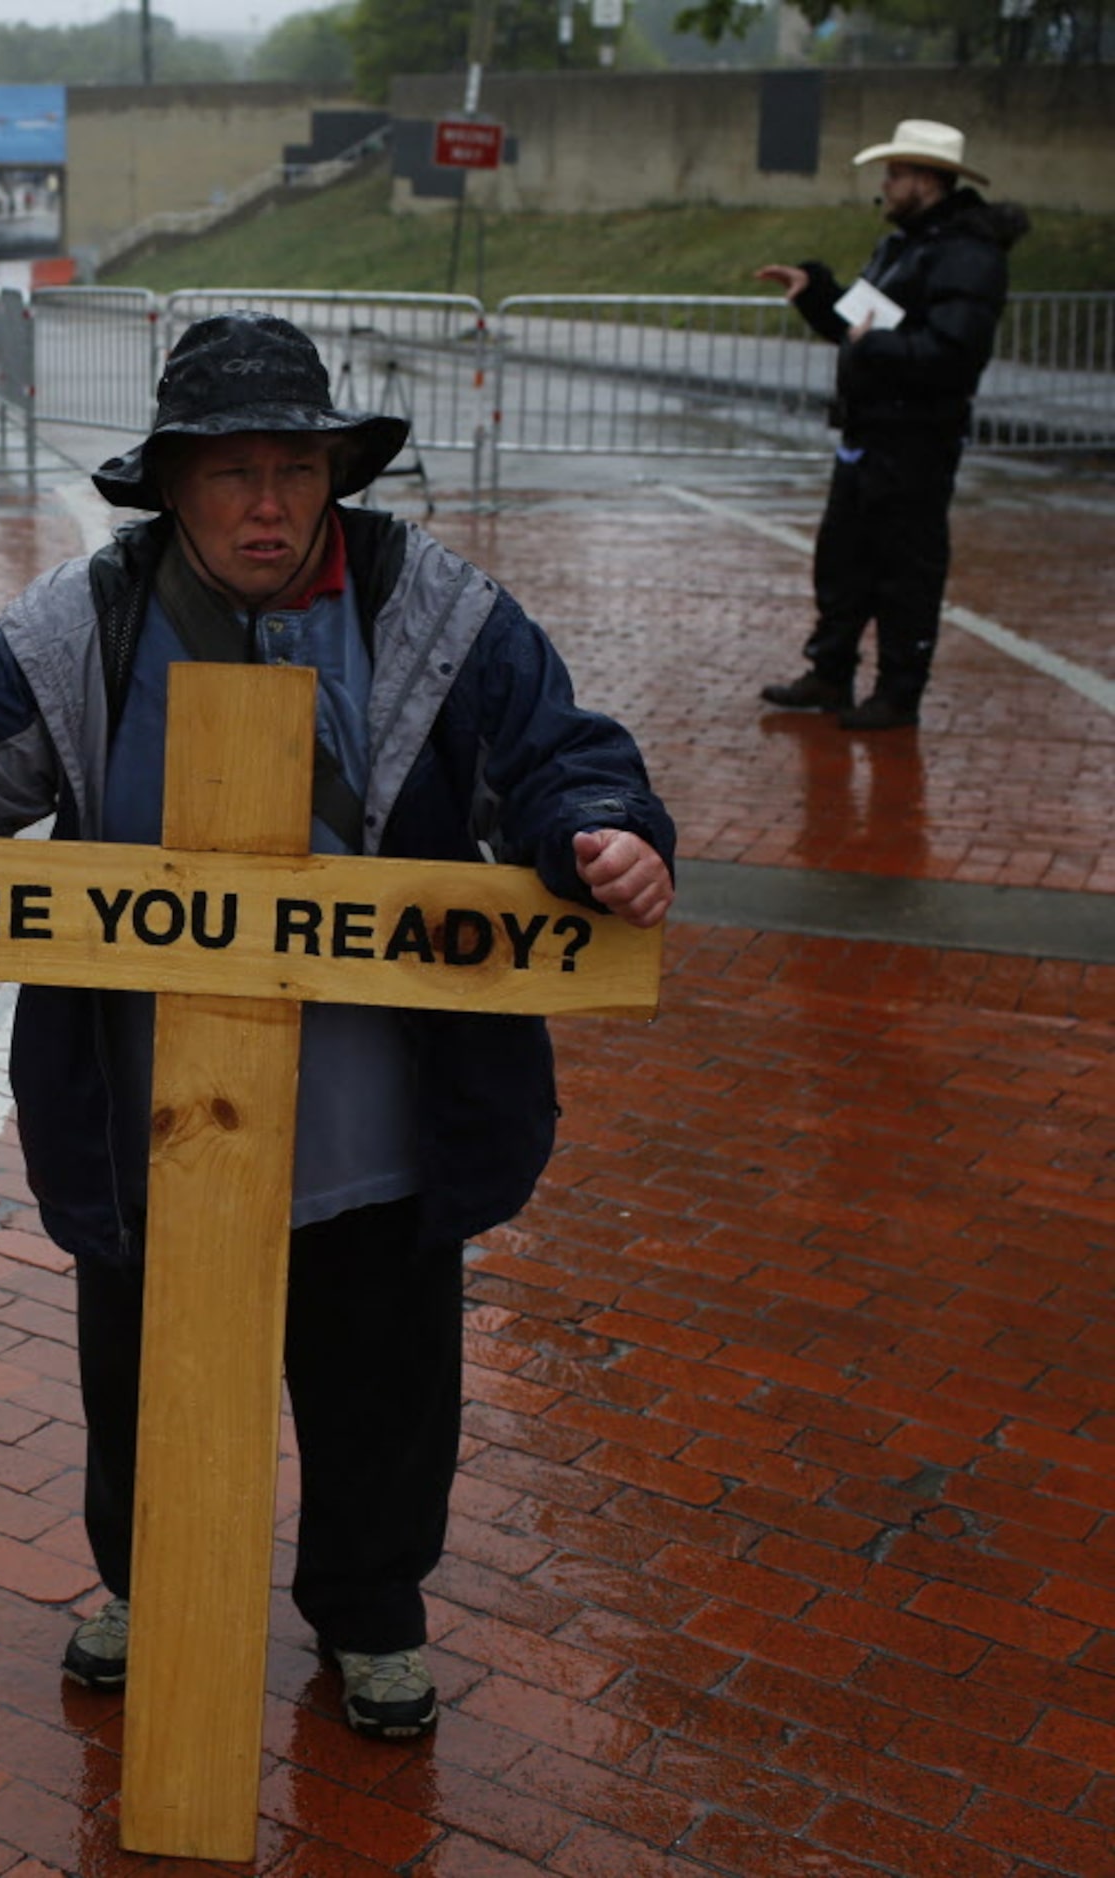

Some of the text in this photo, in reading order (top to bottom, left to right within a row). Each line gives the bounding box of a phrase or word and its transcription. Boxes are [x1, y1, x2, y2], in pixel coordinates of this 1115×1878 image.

[442, 126, 495, 145] WRONG
[87, 887, 238, 950] YOU
[274, 898, 593, 973] READY?
